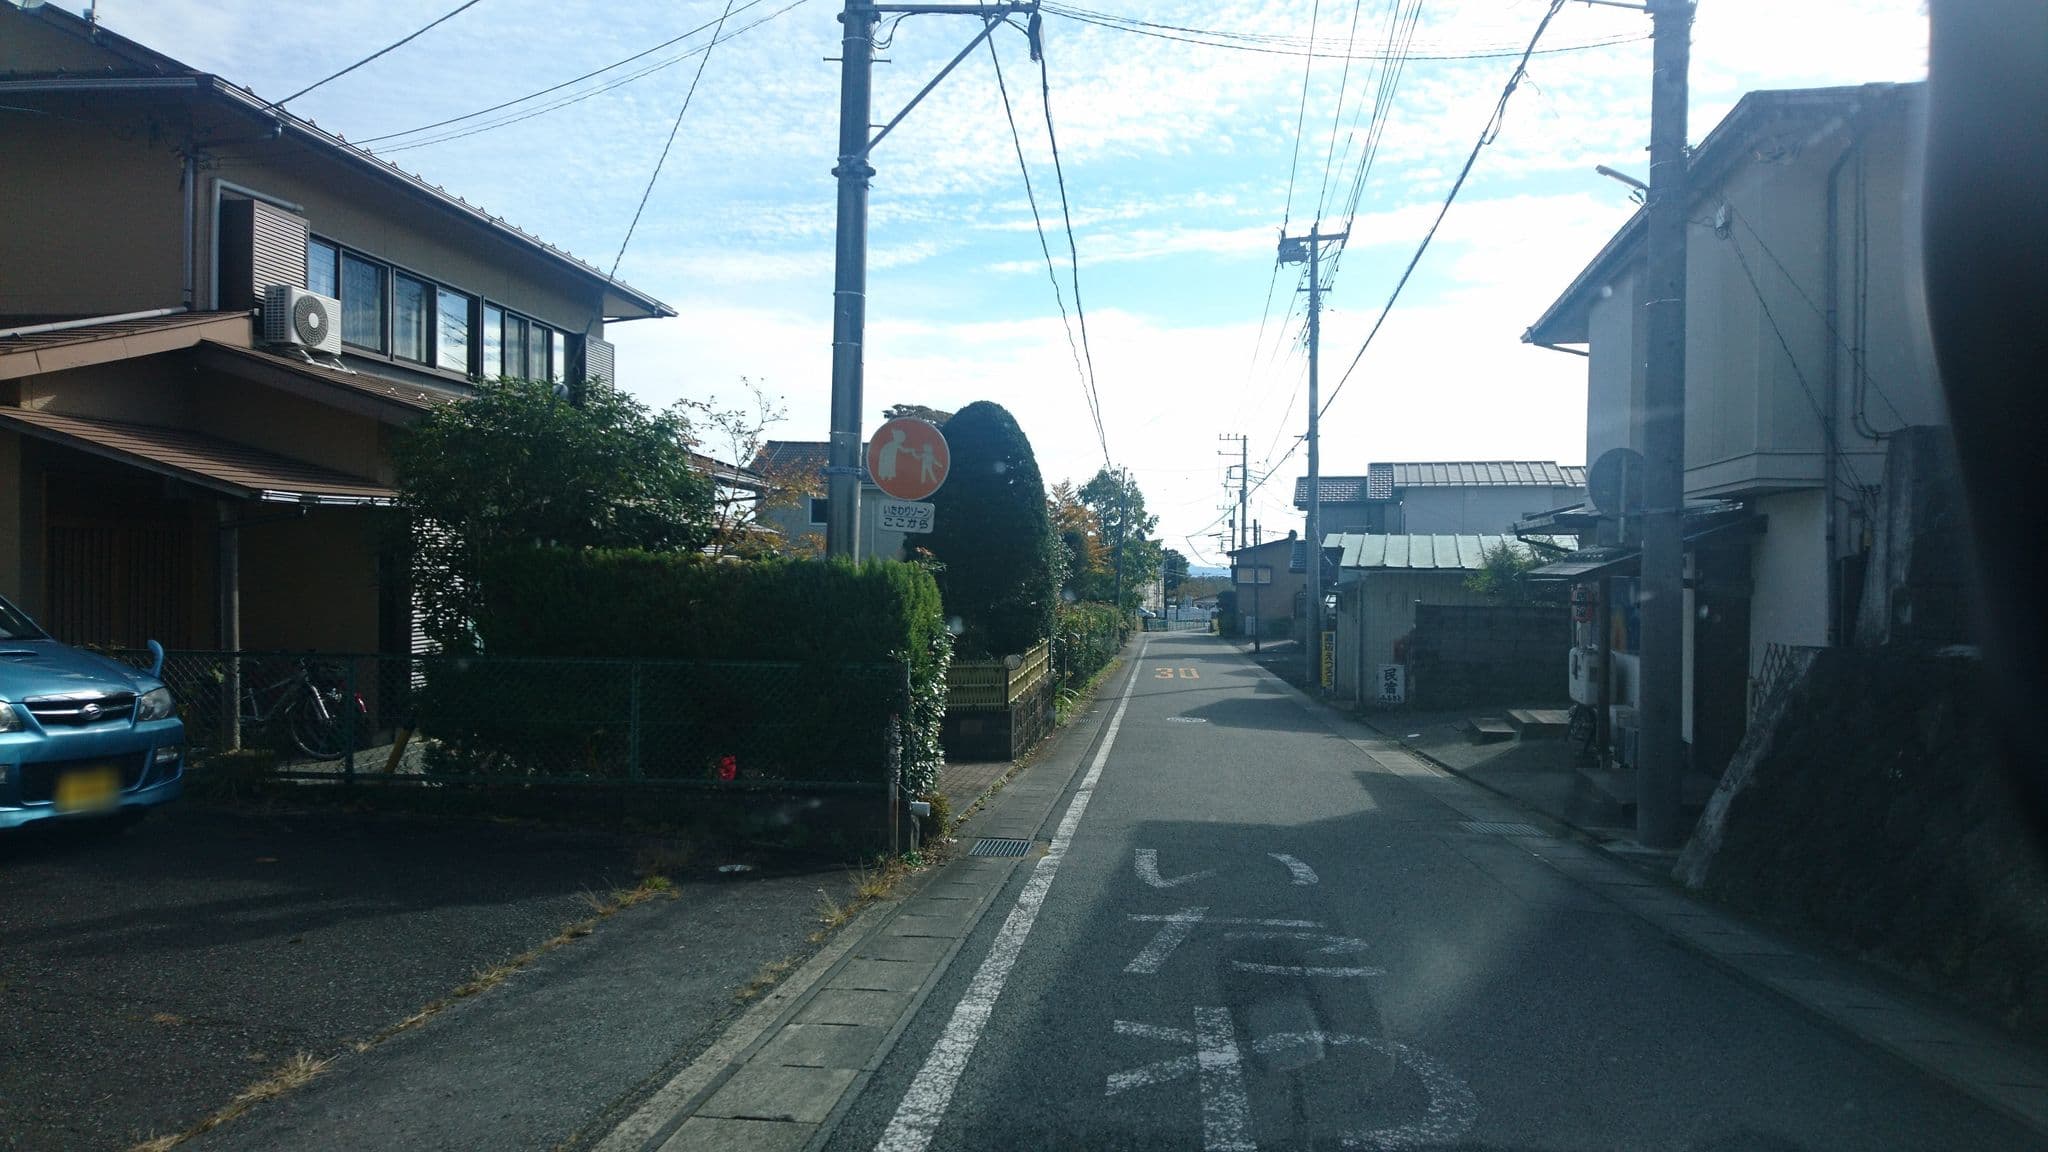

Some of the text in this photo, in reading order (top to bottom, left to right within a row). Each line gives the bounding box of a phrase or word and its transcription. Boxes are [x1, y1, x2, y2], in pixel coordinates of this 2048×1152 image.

[884, 517, 929, 529] ここから
[1154, 667, 1200, 680] 30
